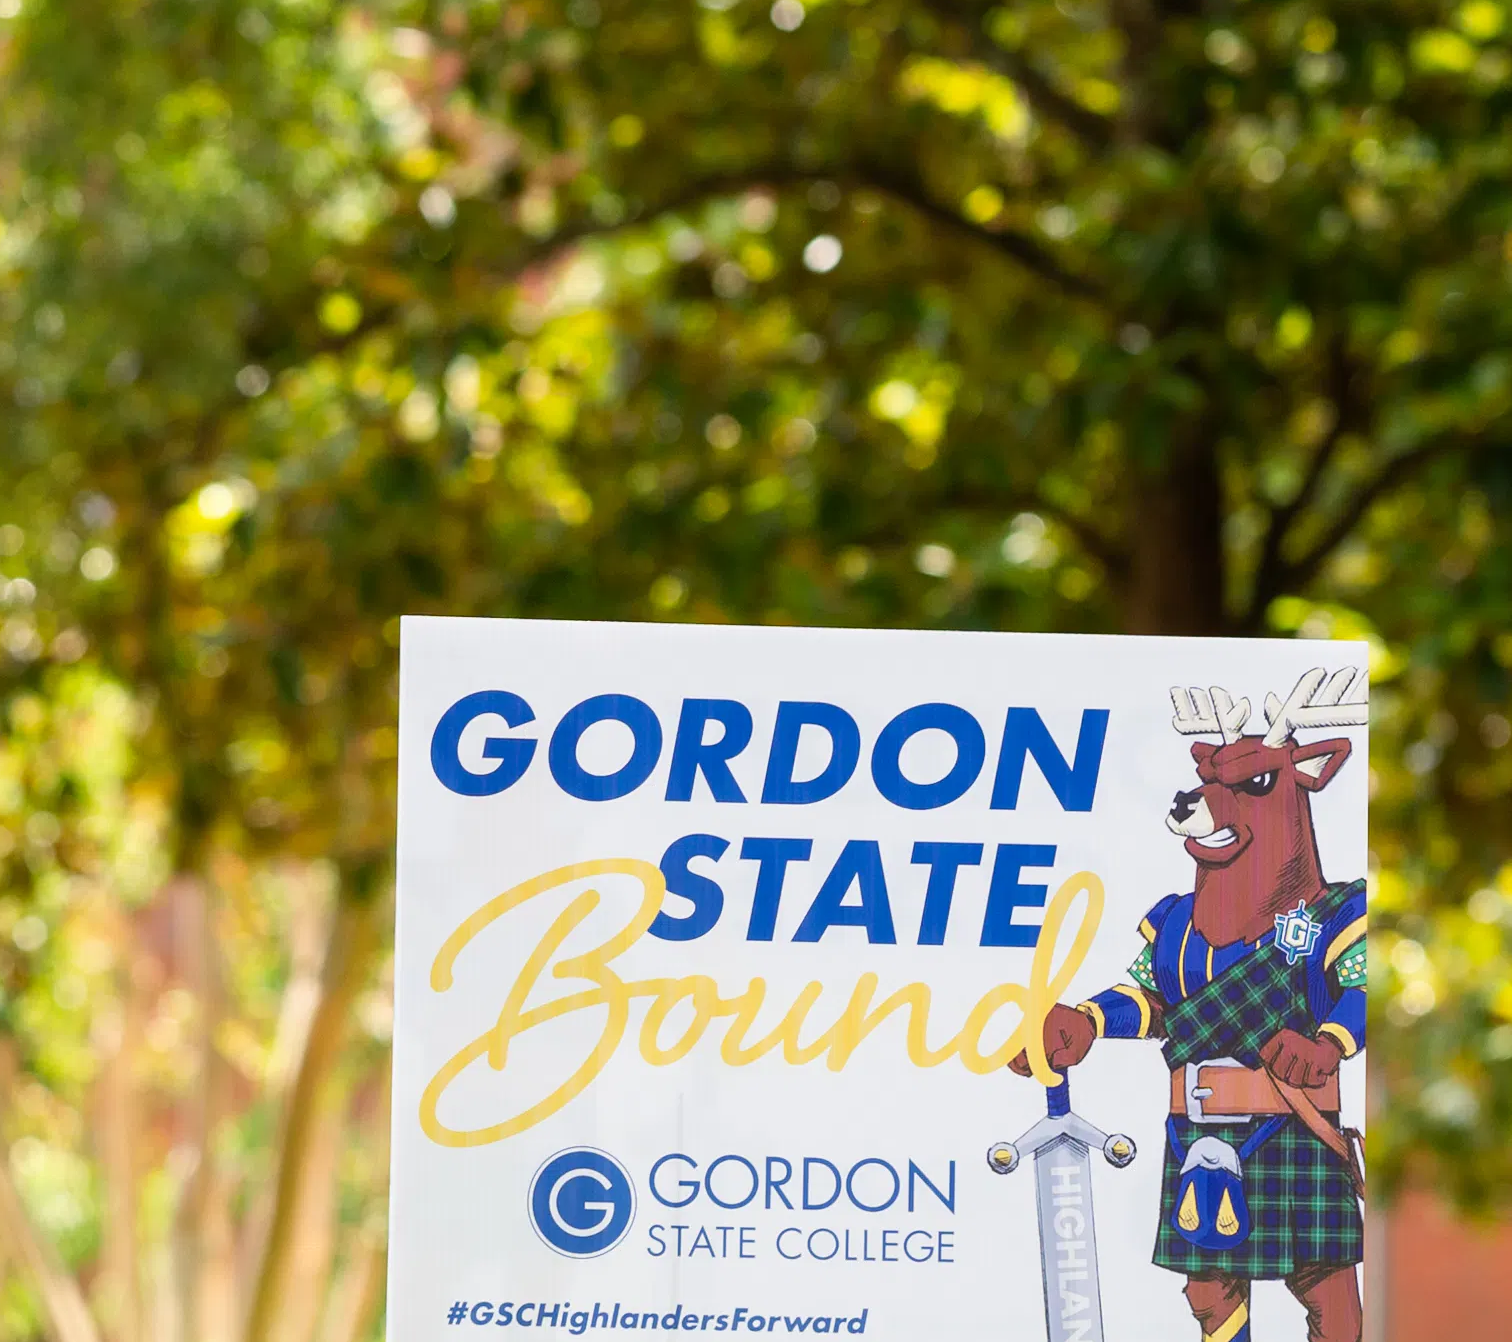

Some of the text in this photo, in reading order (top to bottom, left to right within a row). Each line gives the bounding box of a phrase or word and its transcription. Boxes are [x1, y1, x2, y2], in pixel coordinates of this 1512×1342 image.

[430, 690, 1110, 812] GORDON
[647, 833, 1058, 948] STATE
[418, 857, 1105, 1148] Bound
[648, 1153, 956, 1215] GORDON
[647, 1224, 956, 1263] STATE COLLEGE
[446, 1301, 869, 1335] #GSCHighlandersForward
